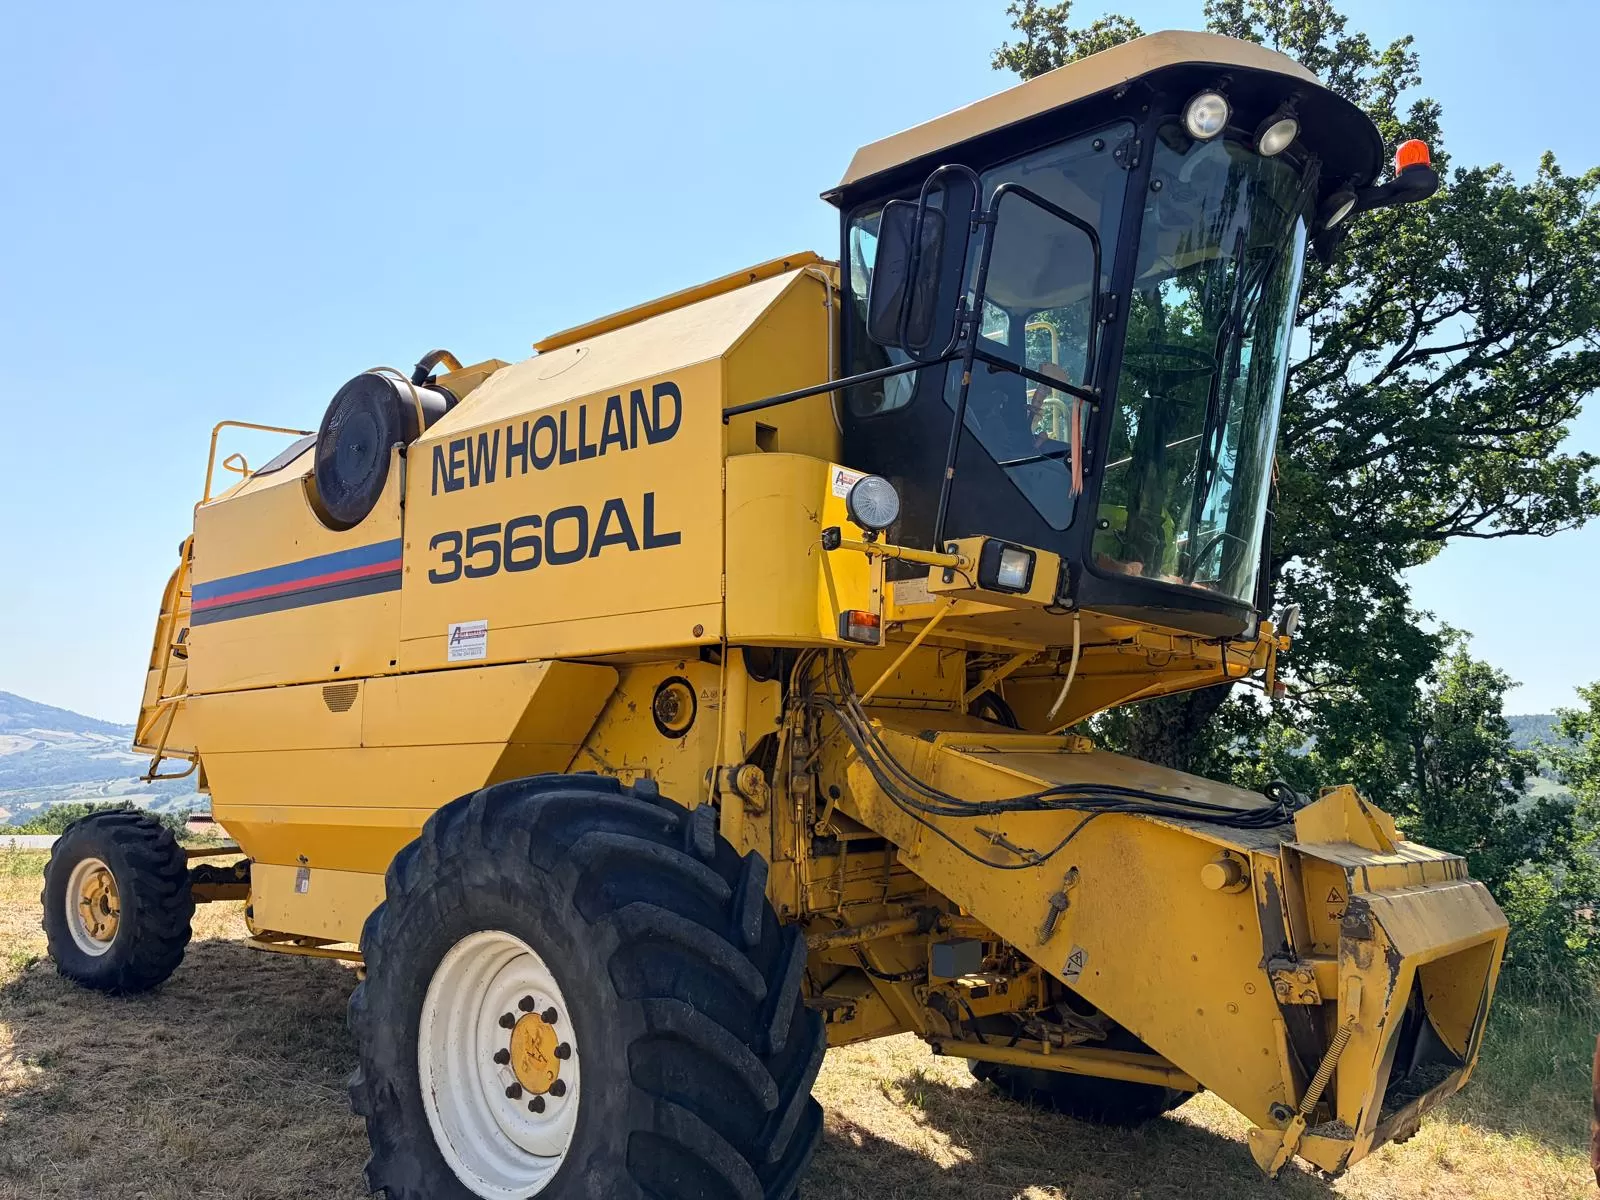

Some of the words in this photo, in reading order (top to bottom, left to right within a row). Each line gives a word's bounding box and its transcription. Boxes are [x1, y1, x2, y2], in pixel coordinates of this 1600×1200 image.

[431, 429, 500, 496] NEW
[505, 381, 683, 478] HOLLAND
[428, 491, 681, 585] 3560AL
